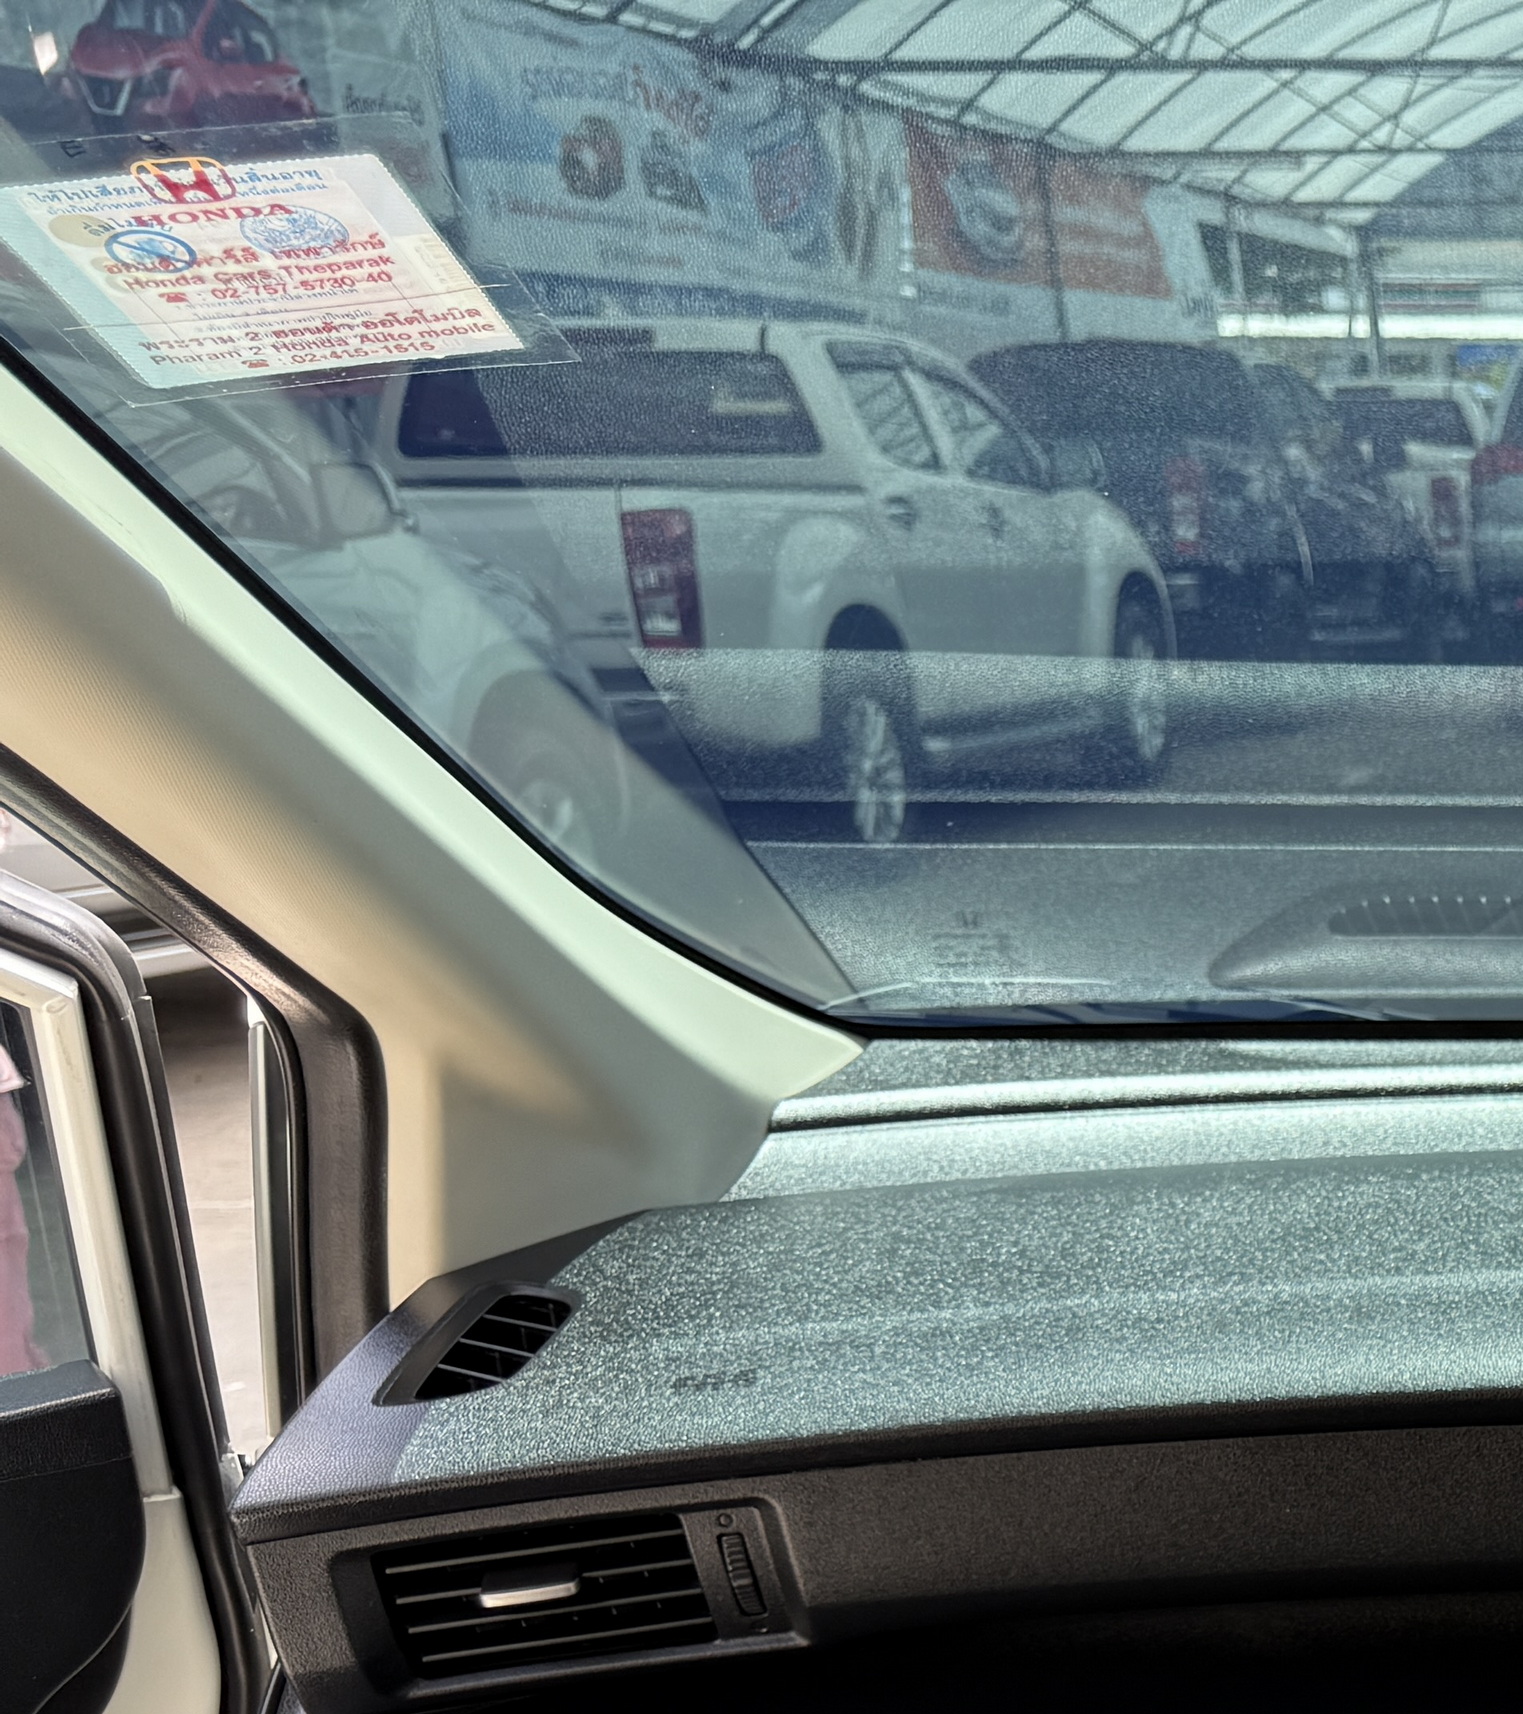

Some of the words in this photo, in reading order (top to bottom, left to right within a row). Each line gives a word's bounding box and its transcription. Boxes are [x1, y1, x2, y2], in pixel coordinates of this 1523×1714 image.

[132, 203, 294, 227] HONDA
[123, 273, 206, 292] Honda
[213, 268, 273, 285] Cars
[278, 254, 396, 277] Theparak
[211, 270, 393, 300] 02-757-5730-40
[138, 334, 236, 351] พระราม
[245, 330, 261, 342] 2
[150, 346, 243, 367] Pharam
[251, 345, 265, 356] 2
[271, 336, 350, 354] Honda
[357, 329, 412, 347] Auto
[420, 320, 496, 340] mobile
